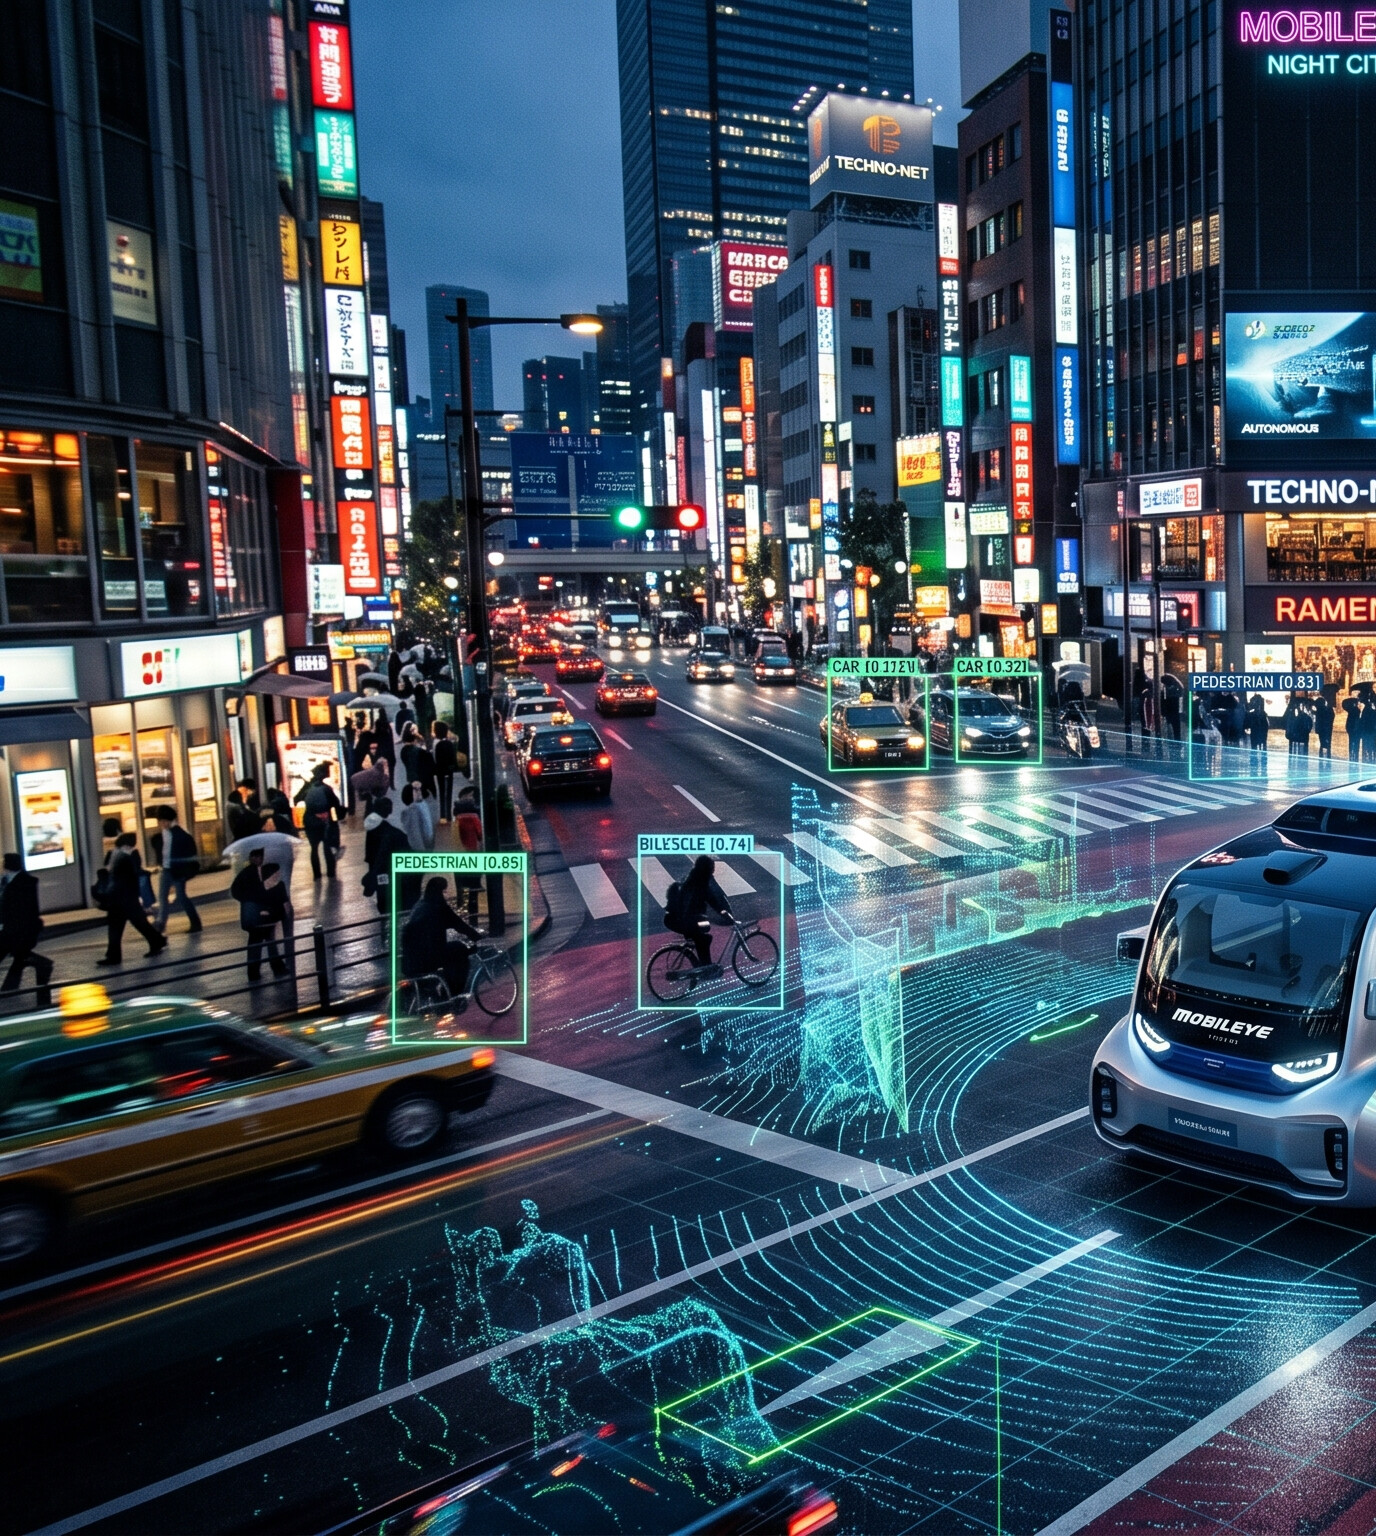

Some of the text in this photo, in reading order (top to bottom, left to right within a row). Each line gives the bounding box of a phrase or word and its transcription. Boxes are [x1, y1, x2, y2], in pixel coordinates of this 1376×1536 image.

[1268, 54, 1340, 75] NIGHT
[835, 155, 929, 180] TECHNO-NET
[1171, 1008, 1274, 1039] MOBILEYE
